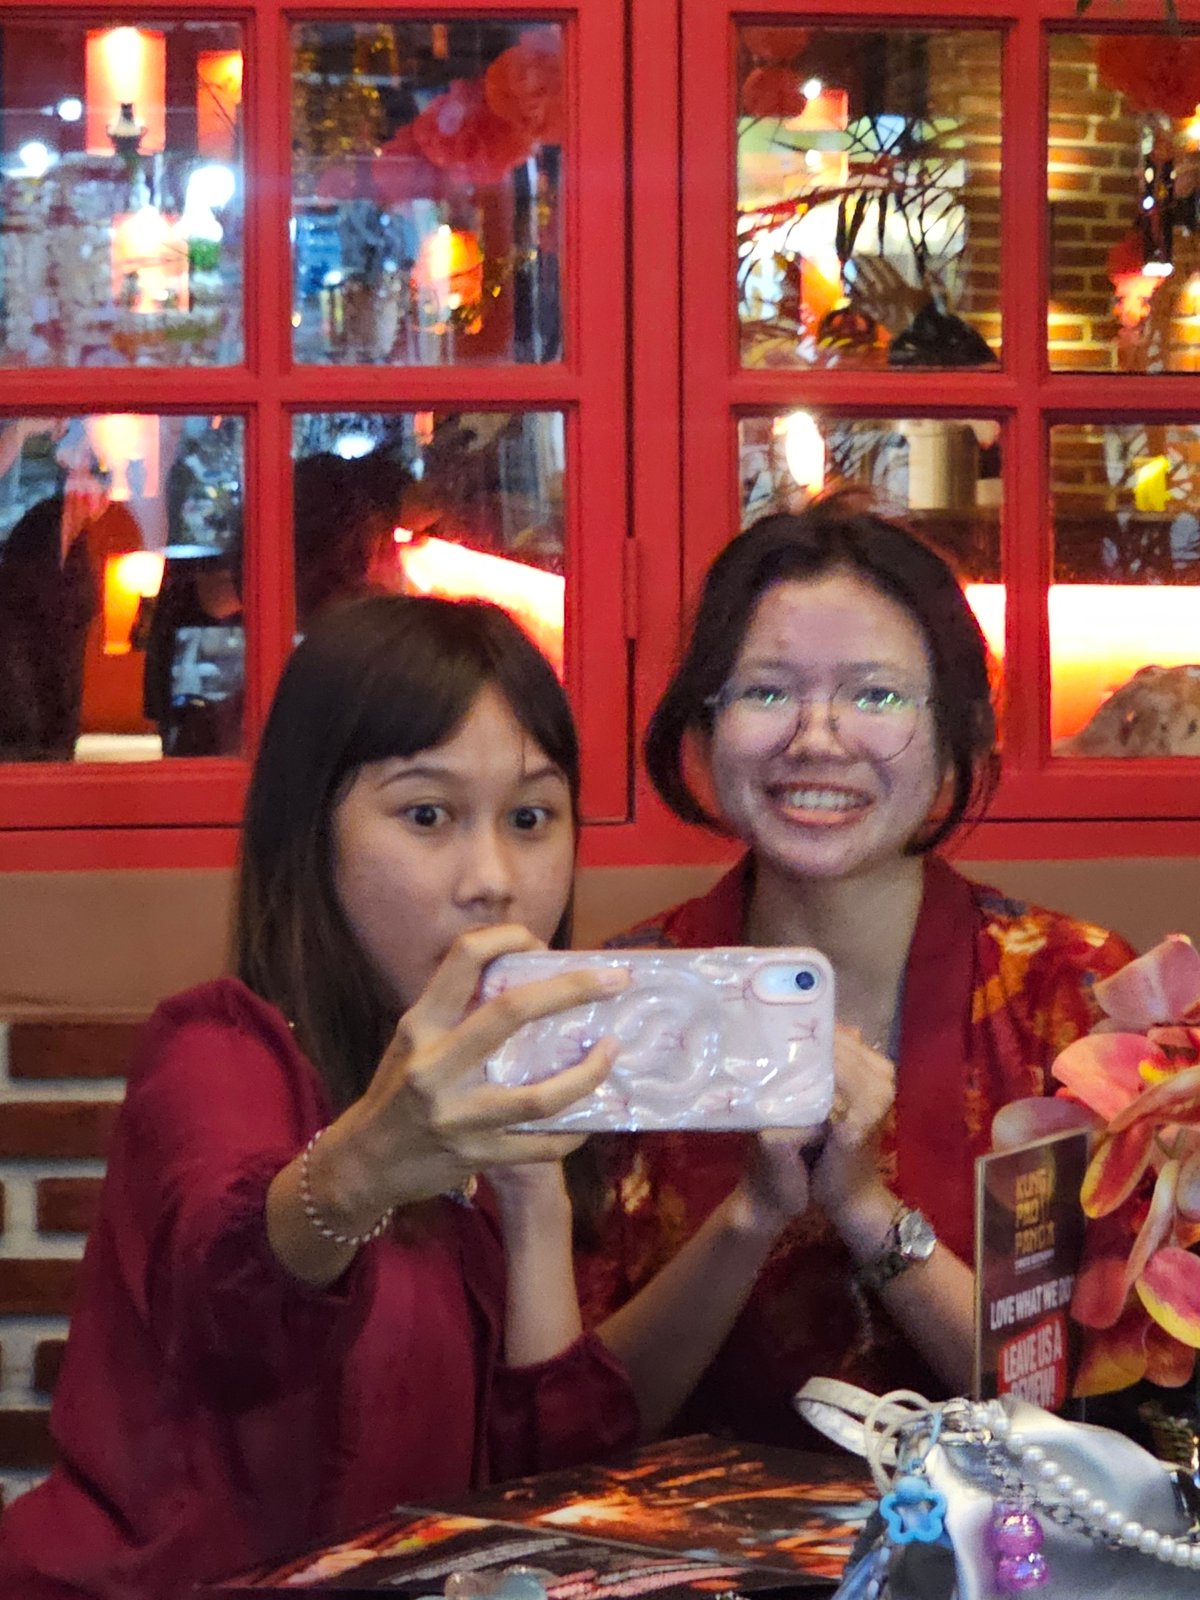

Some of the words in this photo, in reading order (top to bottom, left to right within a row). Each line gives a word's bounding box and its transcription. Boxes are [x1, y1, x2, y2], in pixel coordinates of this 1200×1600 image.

[990, 1295, 1015, 1330] LOVE
[1015, 1285, 1043, 1321] WHAT
[1042, 1279, 1058, 1311] WE
[1004, 1333, 1037, 1384] LEAVE
[1037, 1324, 1053, 1368] US
[1053, 1319, 1062, 1361] A
